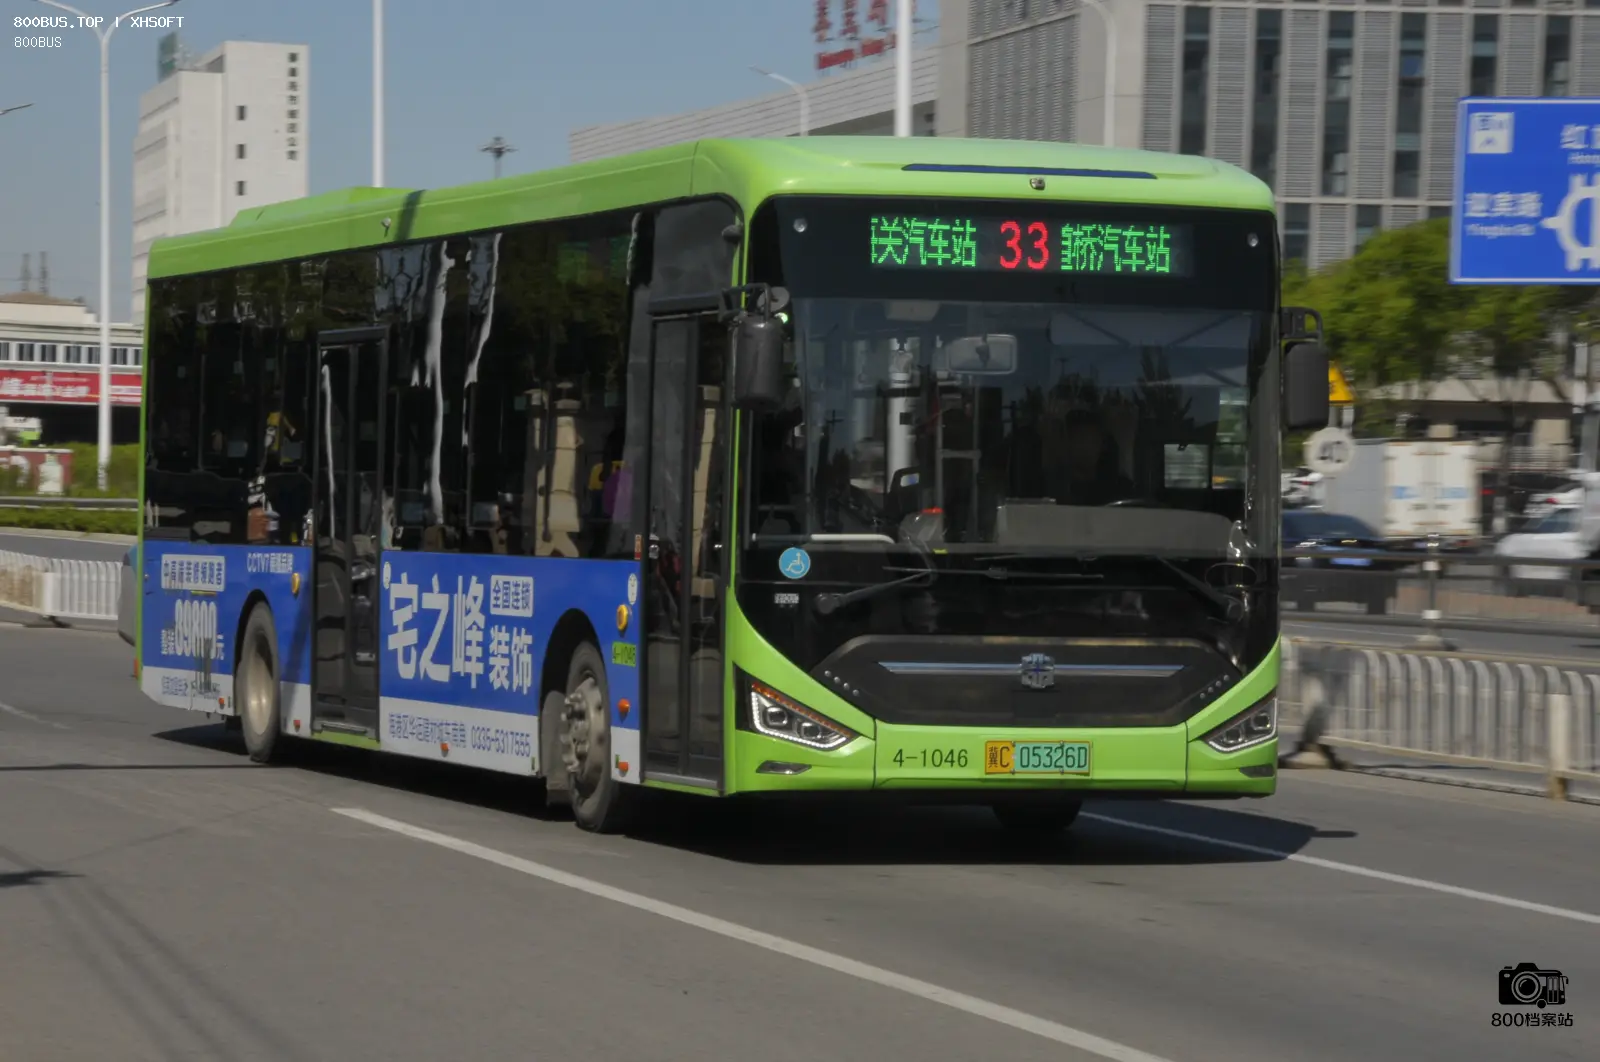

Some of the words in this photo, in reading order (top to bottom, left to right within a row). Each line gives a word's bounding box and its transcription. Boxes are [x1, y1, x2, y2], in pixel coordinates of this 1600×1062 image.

[1000, 220, 1050, 270] 33
[492, 579, 531, 611] 全国连锁
[387, 571, 486, 690] 宅之峰
[489, 624, 533, 695] 装饰
[893, 748, 968, 768] 4-1046
